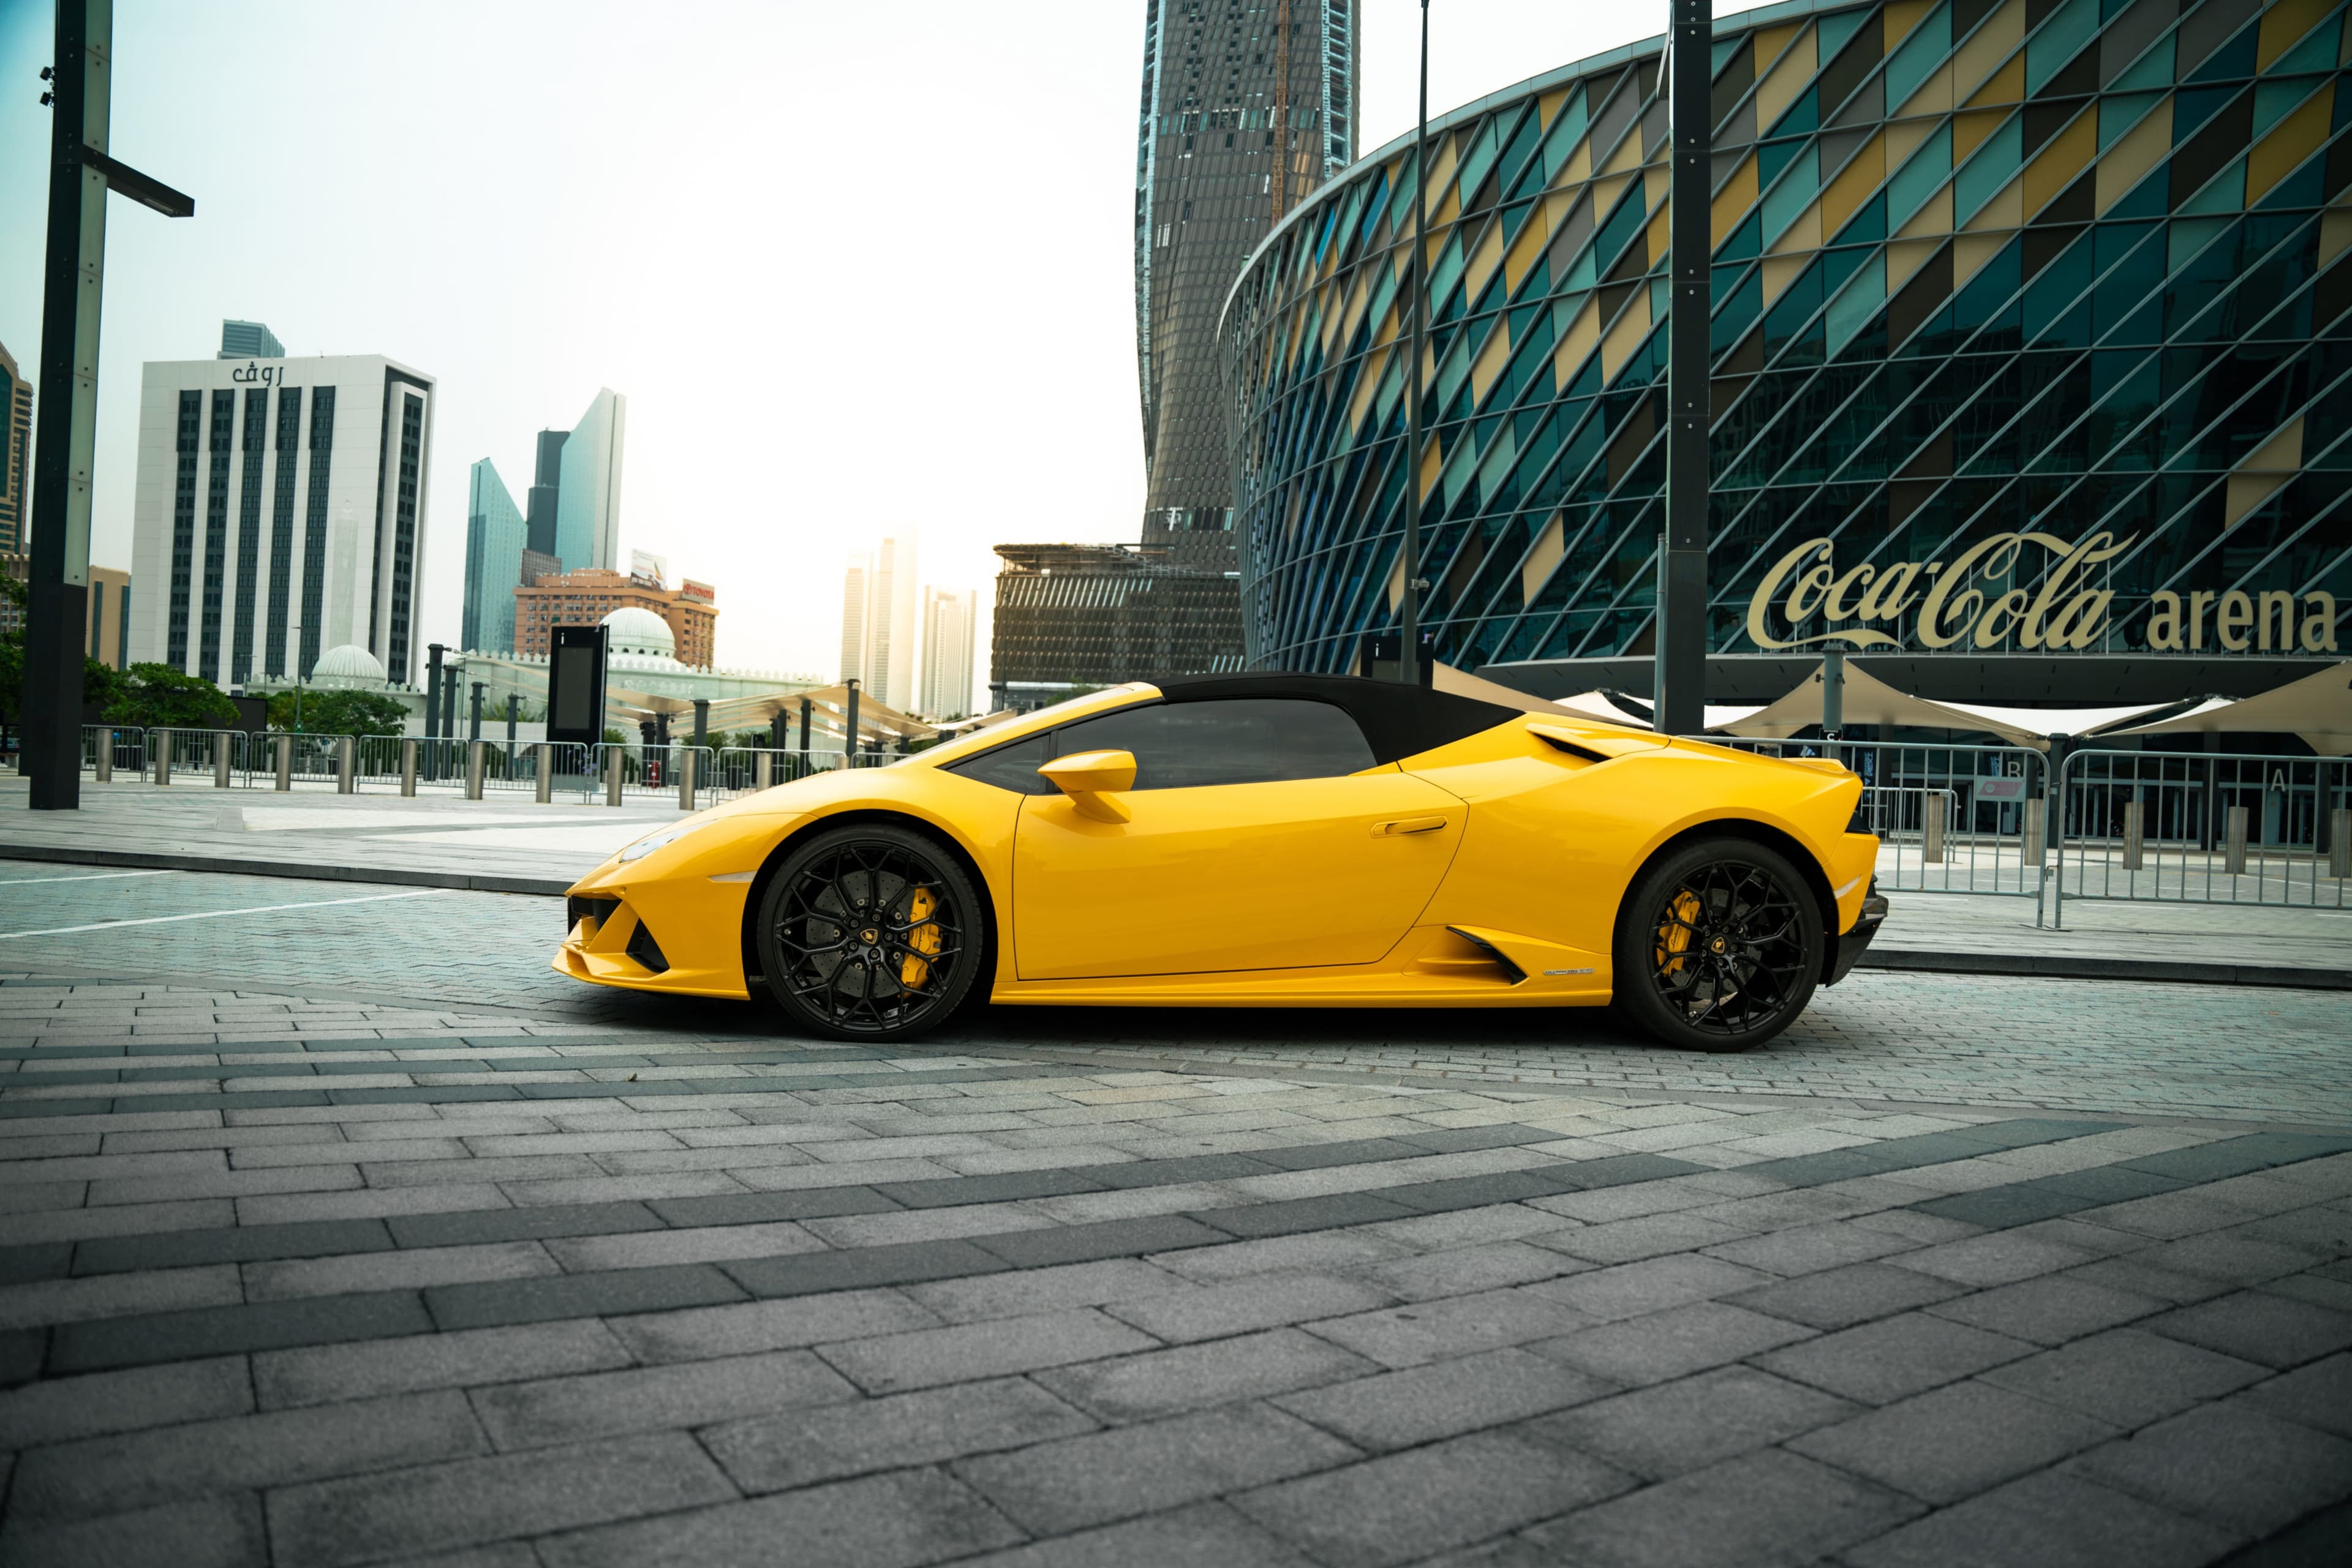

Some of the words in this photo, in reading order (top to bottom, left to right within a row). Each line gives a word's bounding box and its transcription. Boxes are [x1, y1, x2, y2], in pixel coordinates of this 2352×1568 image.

[692, 586, 714, 599] TOYOTA
[1747, 529, 2140, 650] Coca-Cola
[2147, 590, 2338, 652] arena
[2008, 761, 2021, 777] B
[2271, 769, 2286, 791] A
